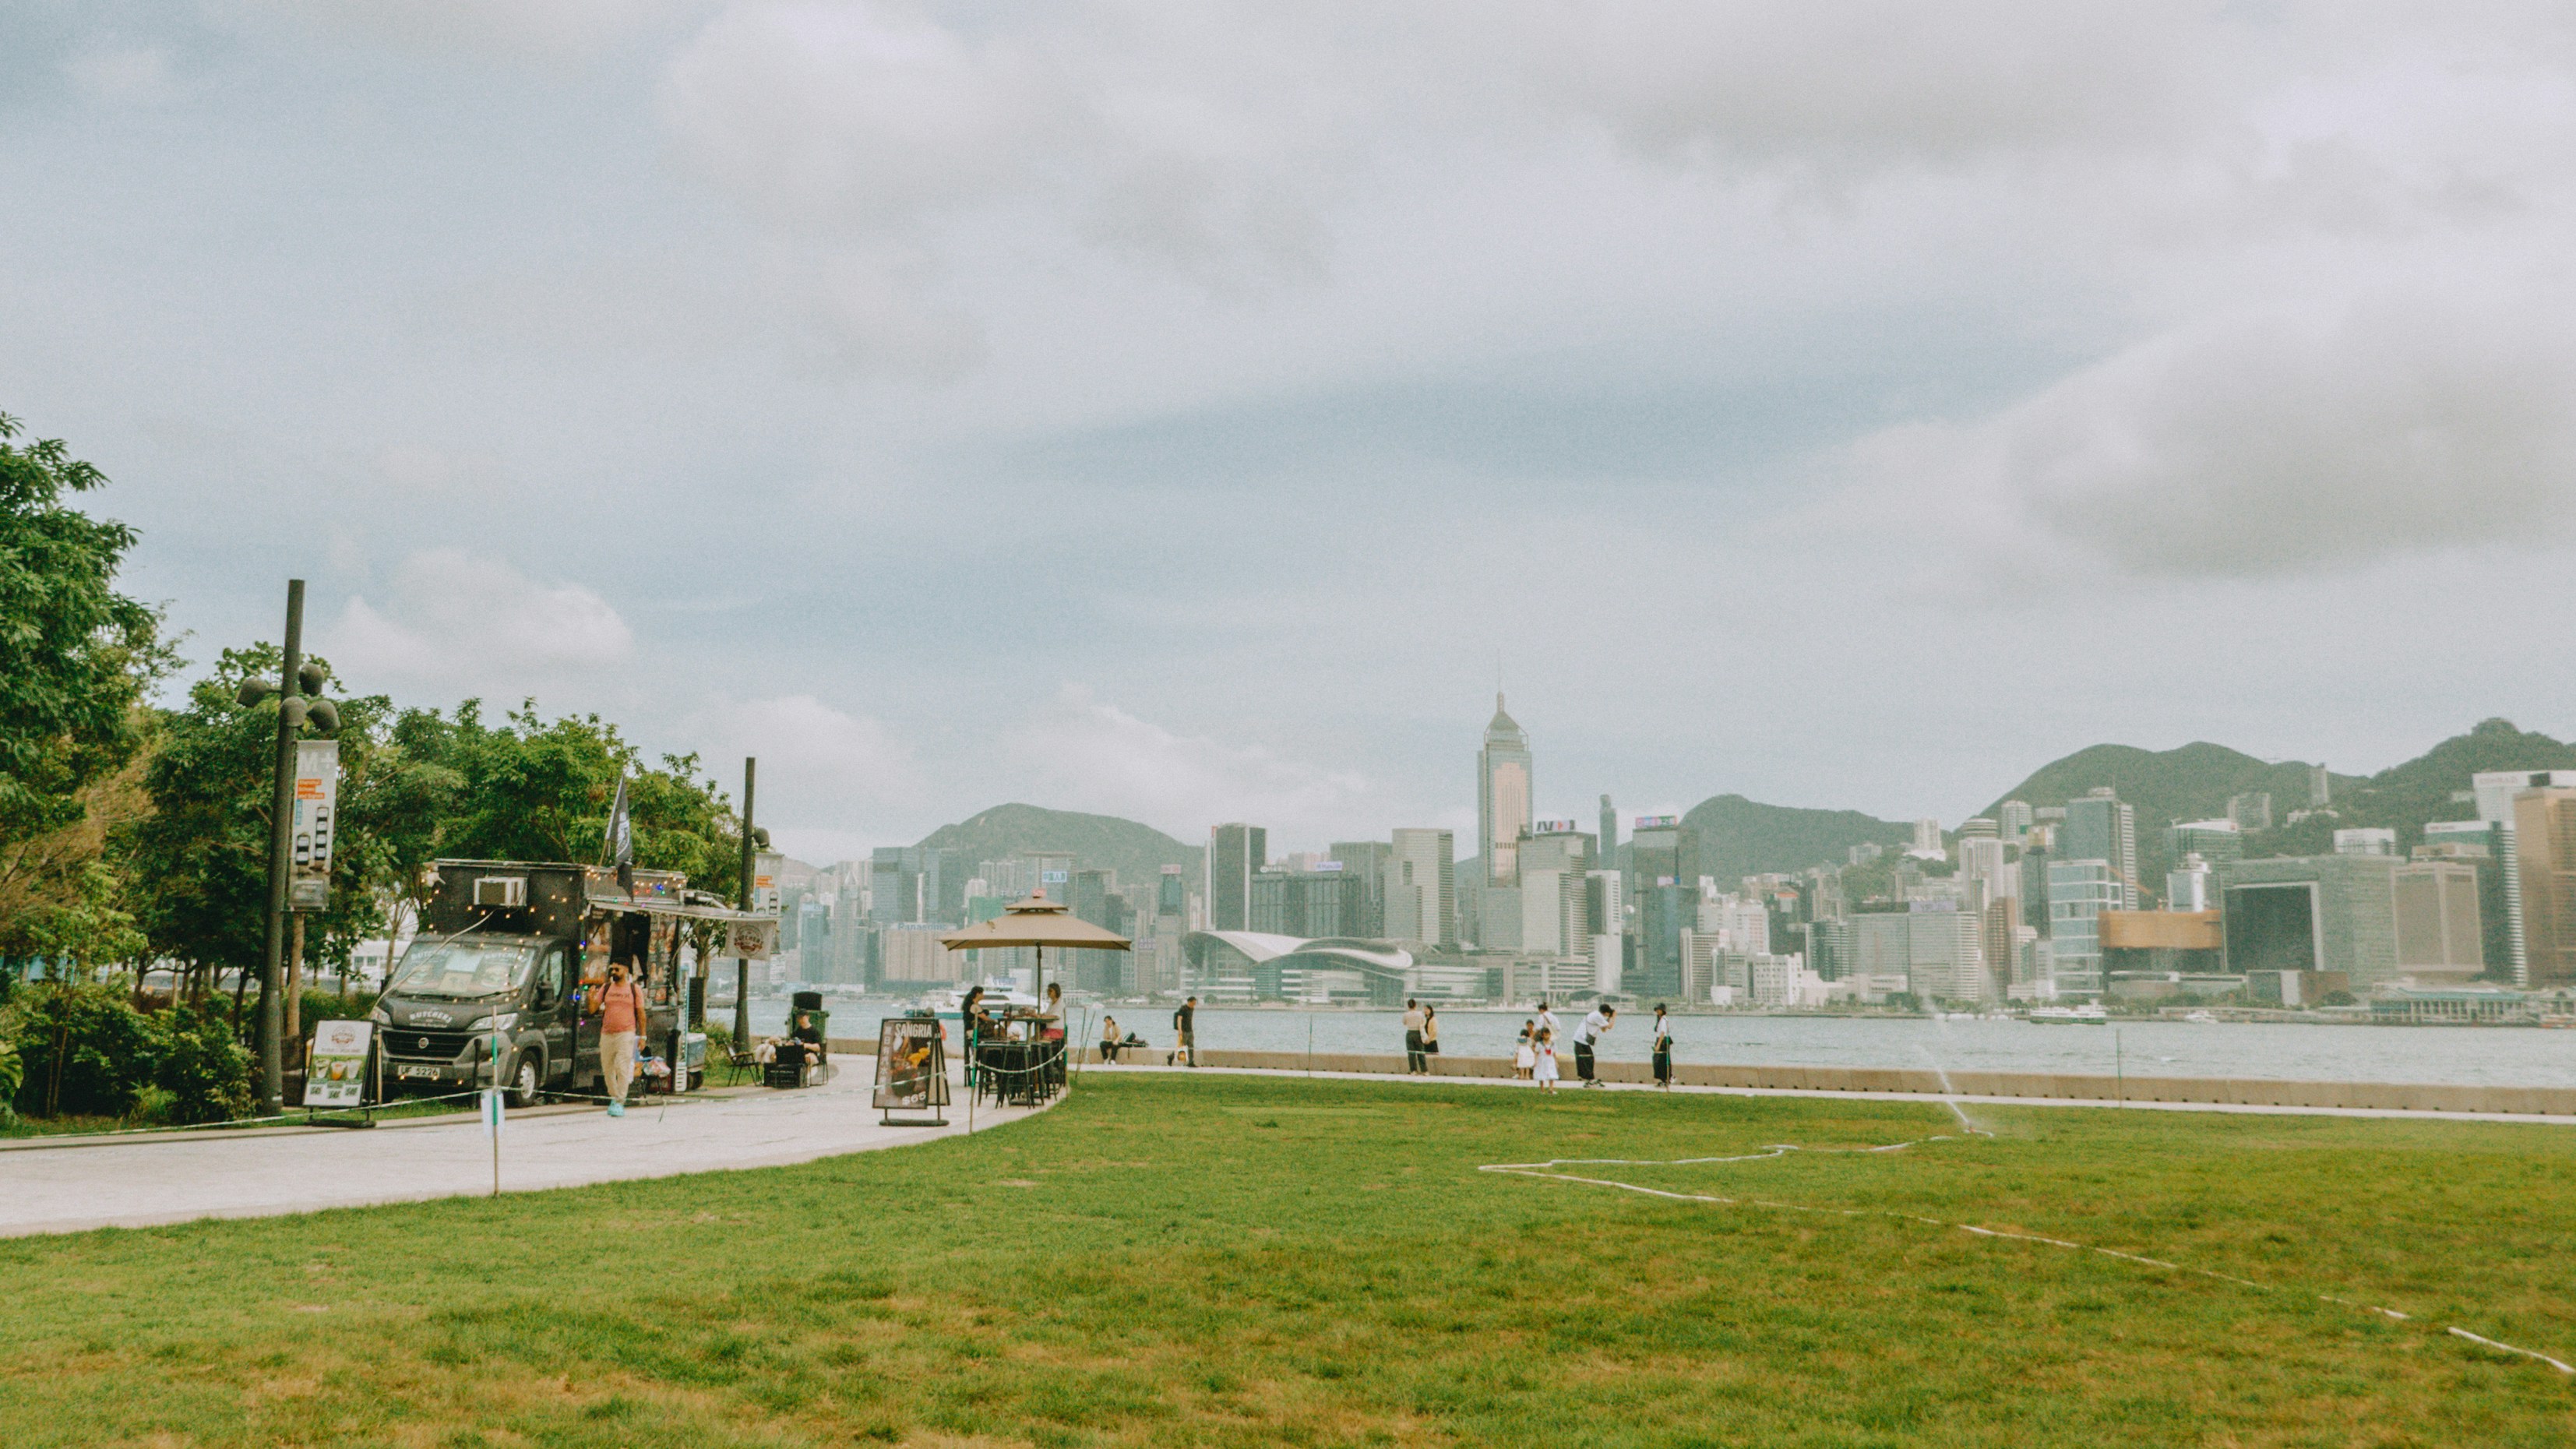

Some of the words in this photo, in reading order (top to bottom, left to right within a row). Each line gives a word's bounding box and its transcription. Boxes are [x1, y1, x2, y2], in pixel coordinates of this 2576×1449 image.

[298, 751, 336, 772] M+
[897, 922, 947, 931] Panasonic
[409, 1011, 453, 1024] BUTCHERS
[895, 1023, 932, 1038] SANGRIA
[416, 1066, 439, 1076] 5226
[902, 1091, 926, 1105] $65
